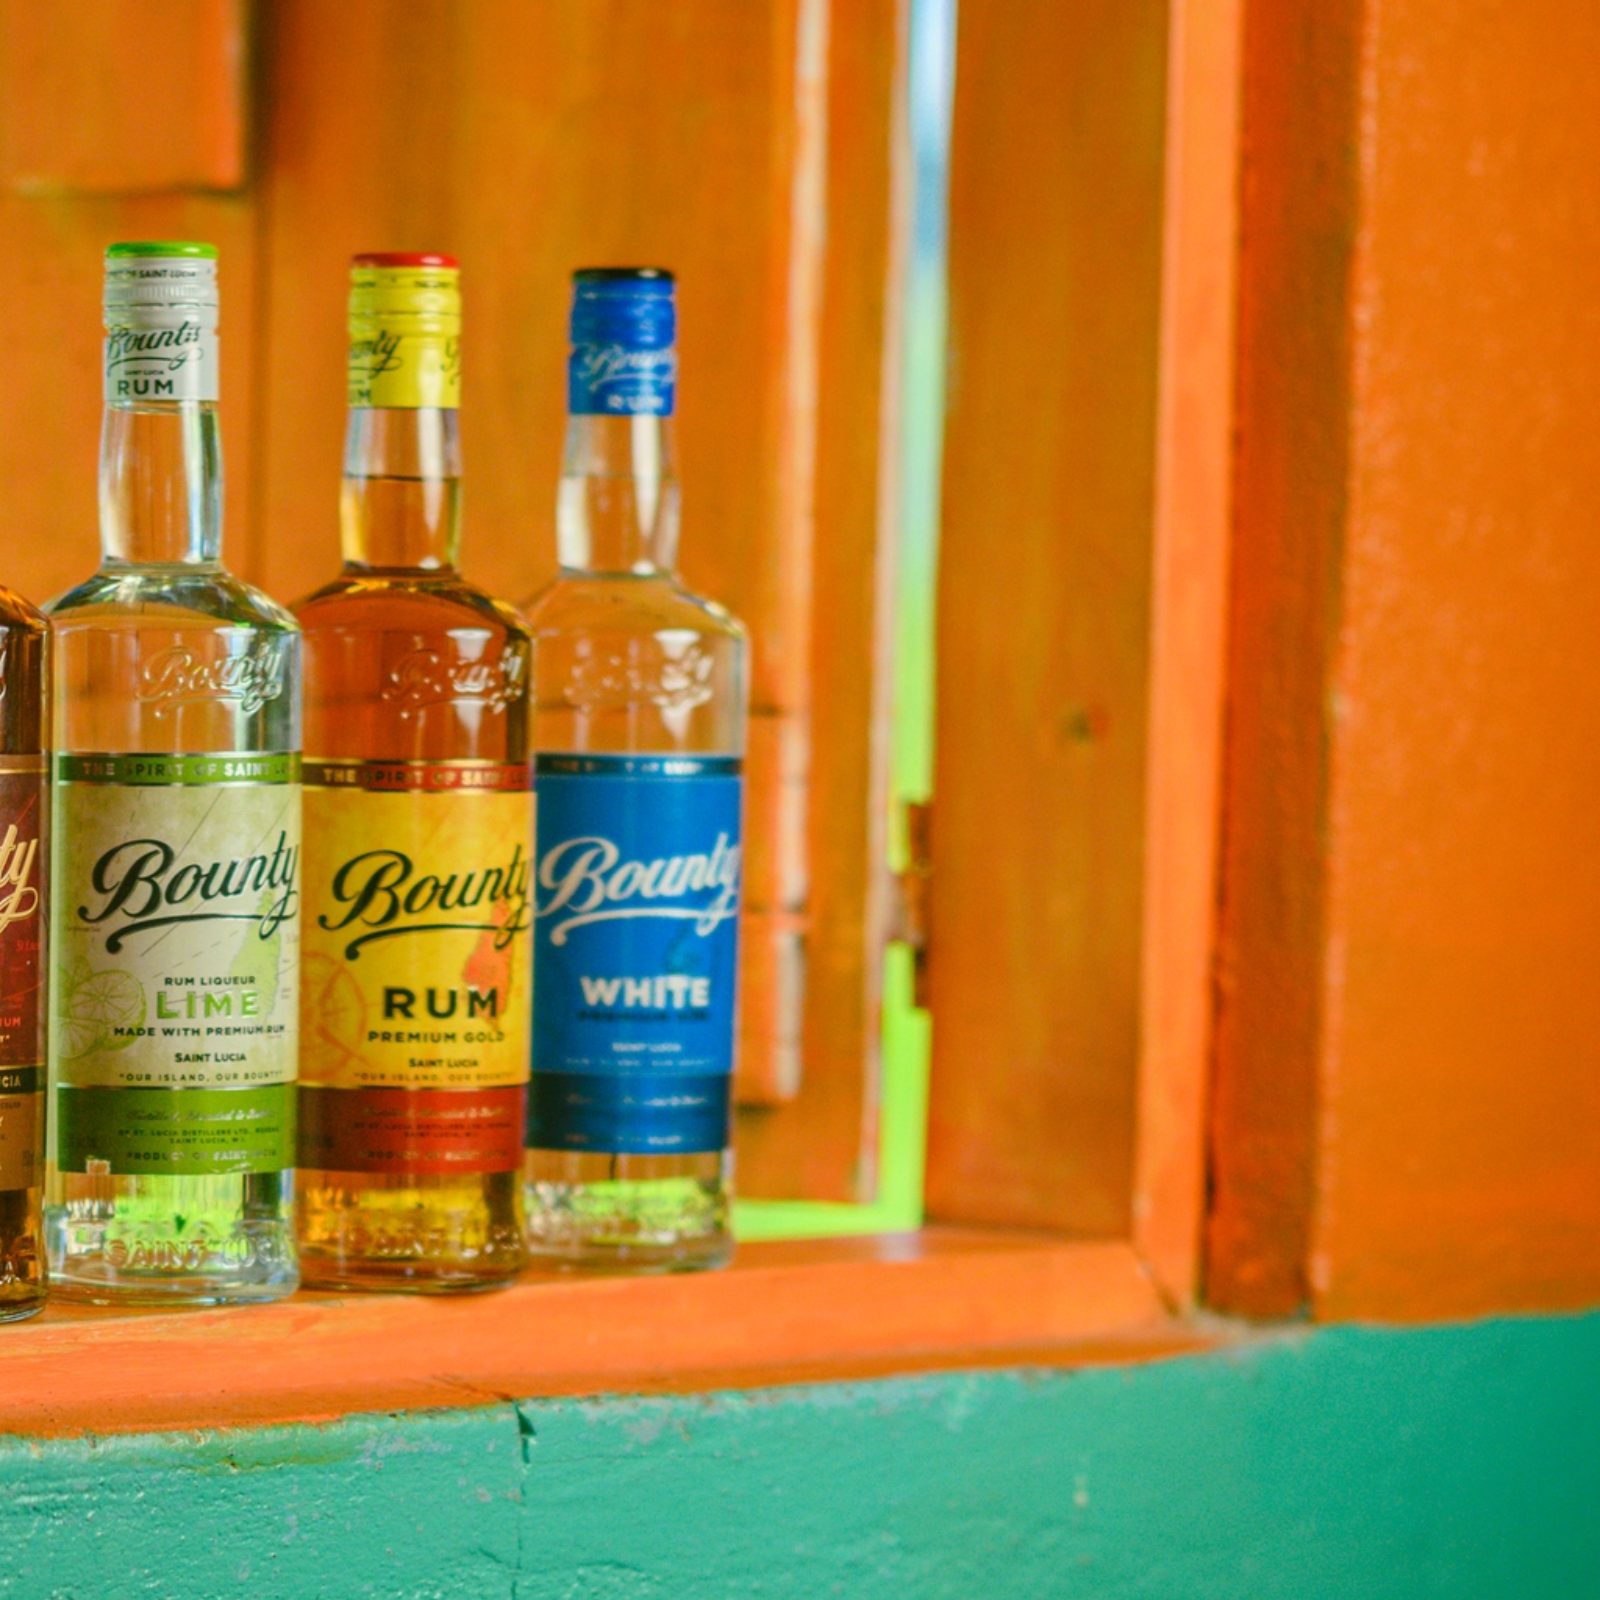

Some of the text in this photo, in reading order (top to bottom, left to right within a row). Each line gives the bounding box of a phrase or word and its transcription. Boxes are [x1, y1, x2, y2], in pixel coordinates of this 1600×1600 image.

[117, 379, 174, 396] RUM
[134, 641, 284, 719] Bounty
[82, 762, 116, 777] THE
[194, 762, 217, 777] OF
[224, 762, 272, 777] SAINT
[323, 768, 357, 784] THE
[77, 830, 299, 955] Bounty
[534, 832, 742, 946] Bounty
[318, 843, 532, 961] Bounty
[164, 975, 256, 987] RUM LIQUEUR
[579, 974, 711, 1009] WHITE
[156, 990, 260, 1020] LIME
[383, 986, 499, 1020] RUM
[114, 1023, 286, 1037] MADE WITH PREMIUM RUM
[368, 1030, 505, 1043] PREMIUM GOLD
[174, 1052, 247, 1063] SAINT LUCIA
[408, 1057, 480, 1069] SAINT LUCIA
[215, 1071, 239, 1082] OUR
